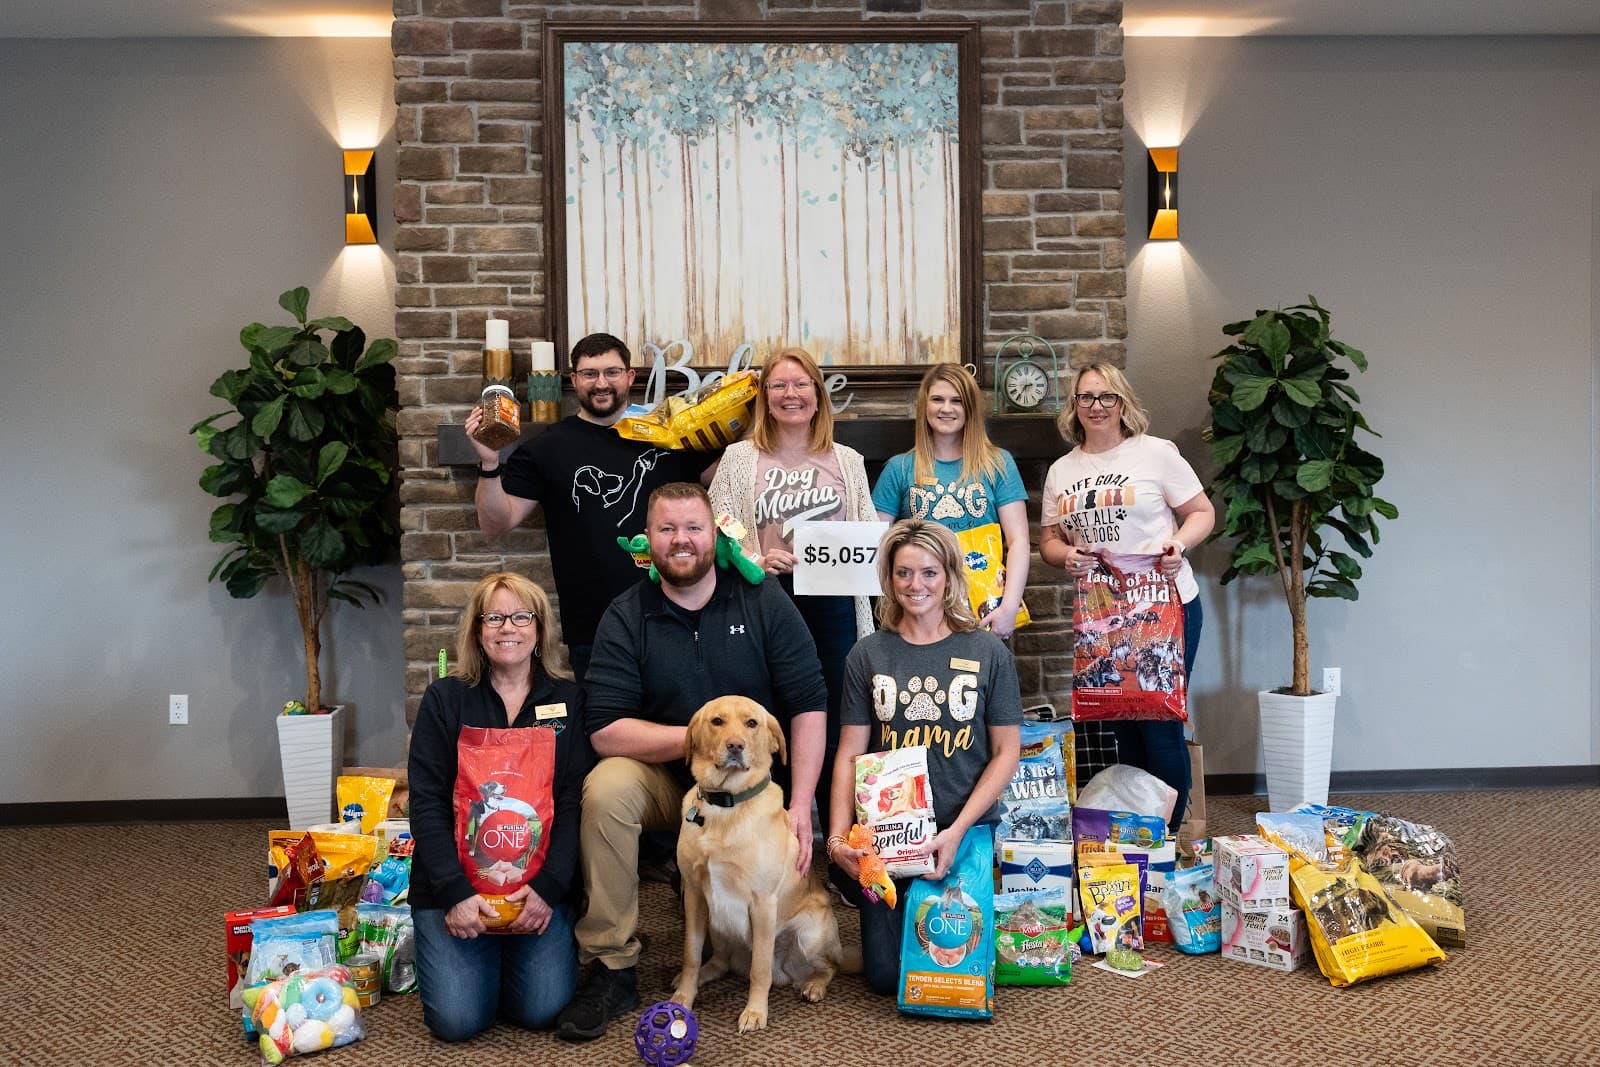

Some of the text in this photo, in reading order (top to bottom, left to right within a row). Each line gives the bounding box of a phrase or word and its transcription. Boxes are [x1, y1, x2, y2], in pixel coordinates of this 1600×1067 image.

[764, 466, 818, 493] Dog
[1064, 473, 1130, 496] LIFE GOAL
[755, 485, 841, 524] Mama
[1070, 508, 1115, 528] PET ALL
[1092, 525, 1120, 544] DOGS
[804, 543, 879, 567] $5,057
[1086, 568, 1168, 588] Taste of the
[1126, 584, 1171, 604] Wild
[880, 722, 975, 758] mama
[1010, 778, 1057, 800] Wild
[876, 823, 903, 832] PURINA
[483, 829, 526, 849] ONE
[928, 916, 967, 936] ONE
[1277, 914, 1289, 923] 24
[1021, 939, 1043, 953] Fiesta
[908, 975, 984, 987] TENDER SELECTS BLEND
